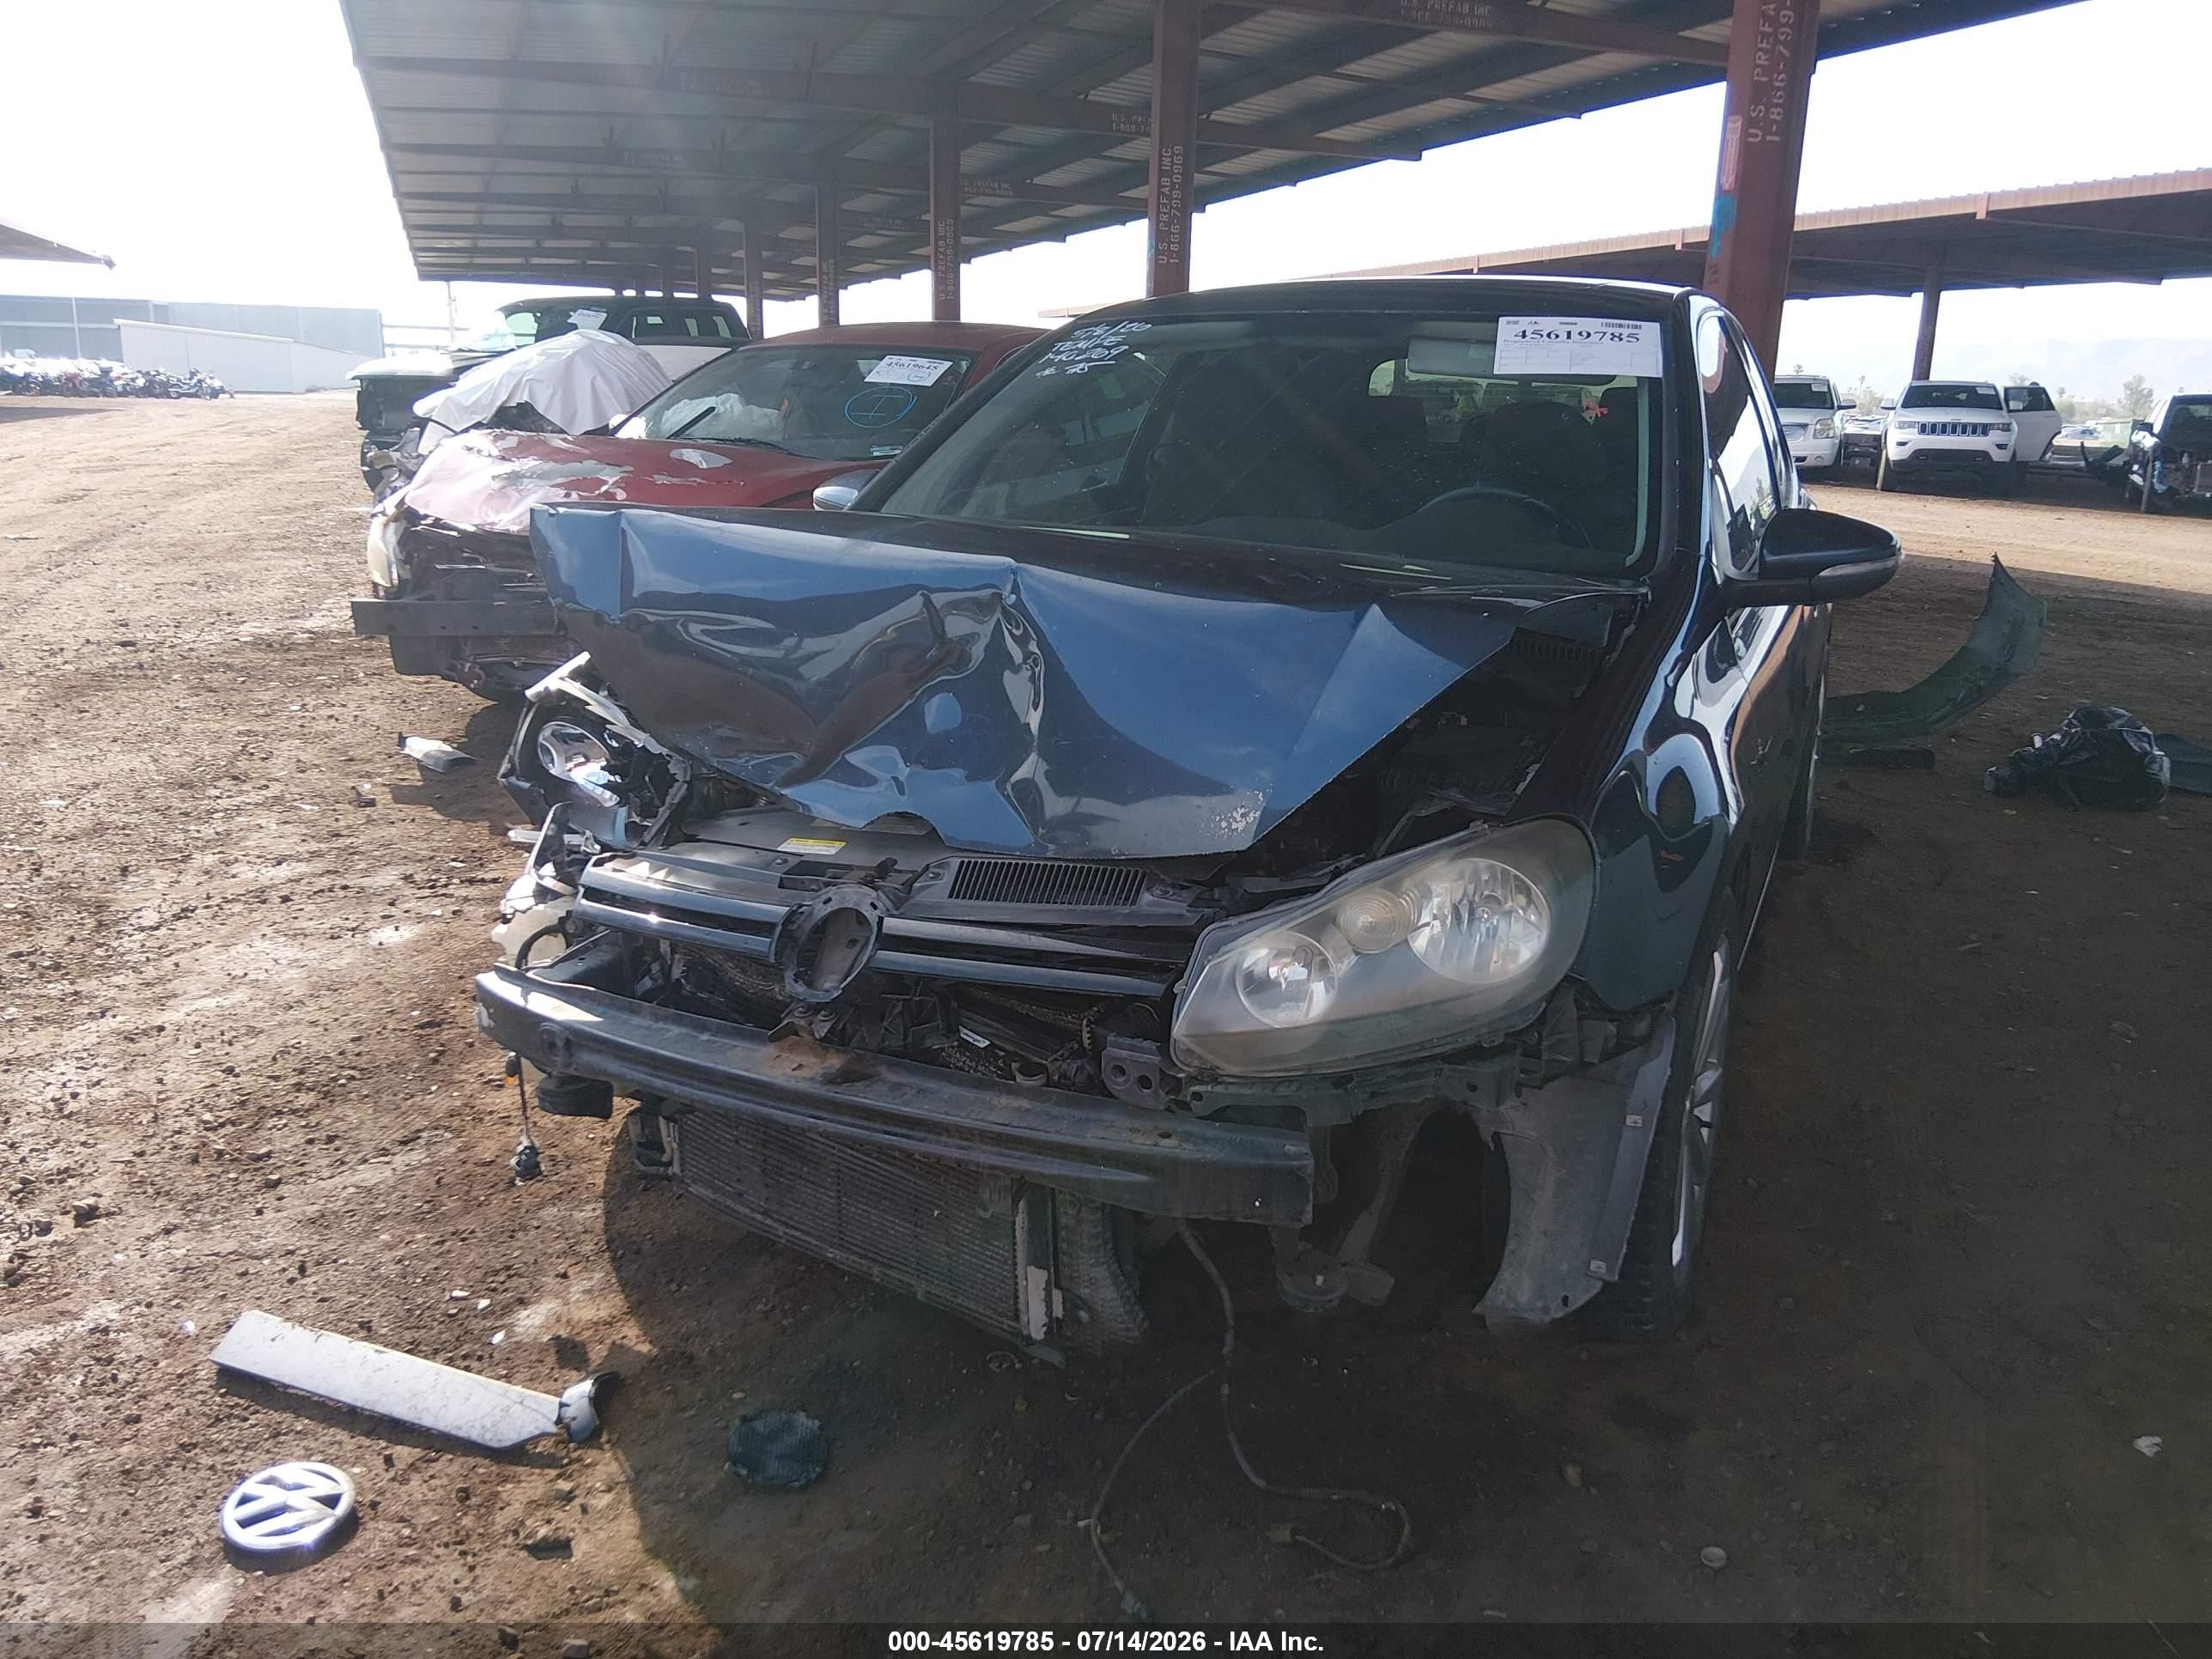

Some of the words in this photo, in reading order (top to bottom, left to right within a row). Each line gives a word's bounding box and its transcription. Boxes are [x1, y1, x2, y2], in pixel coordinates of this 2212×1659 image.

[1747, 98, 1766, 143] U.S.
[1159, 177, 1171, 231] PREFAB
[1170, 145, 1184, 264] 1-866-799-0969
[1513, 328, 1640, 343] 45619785
